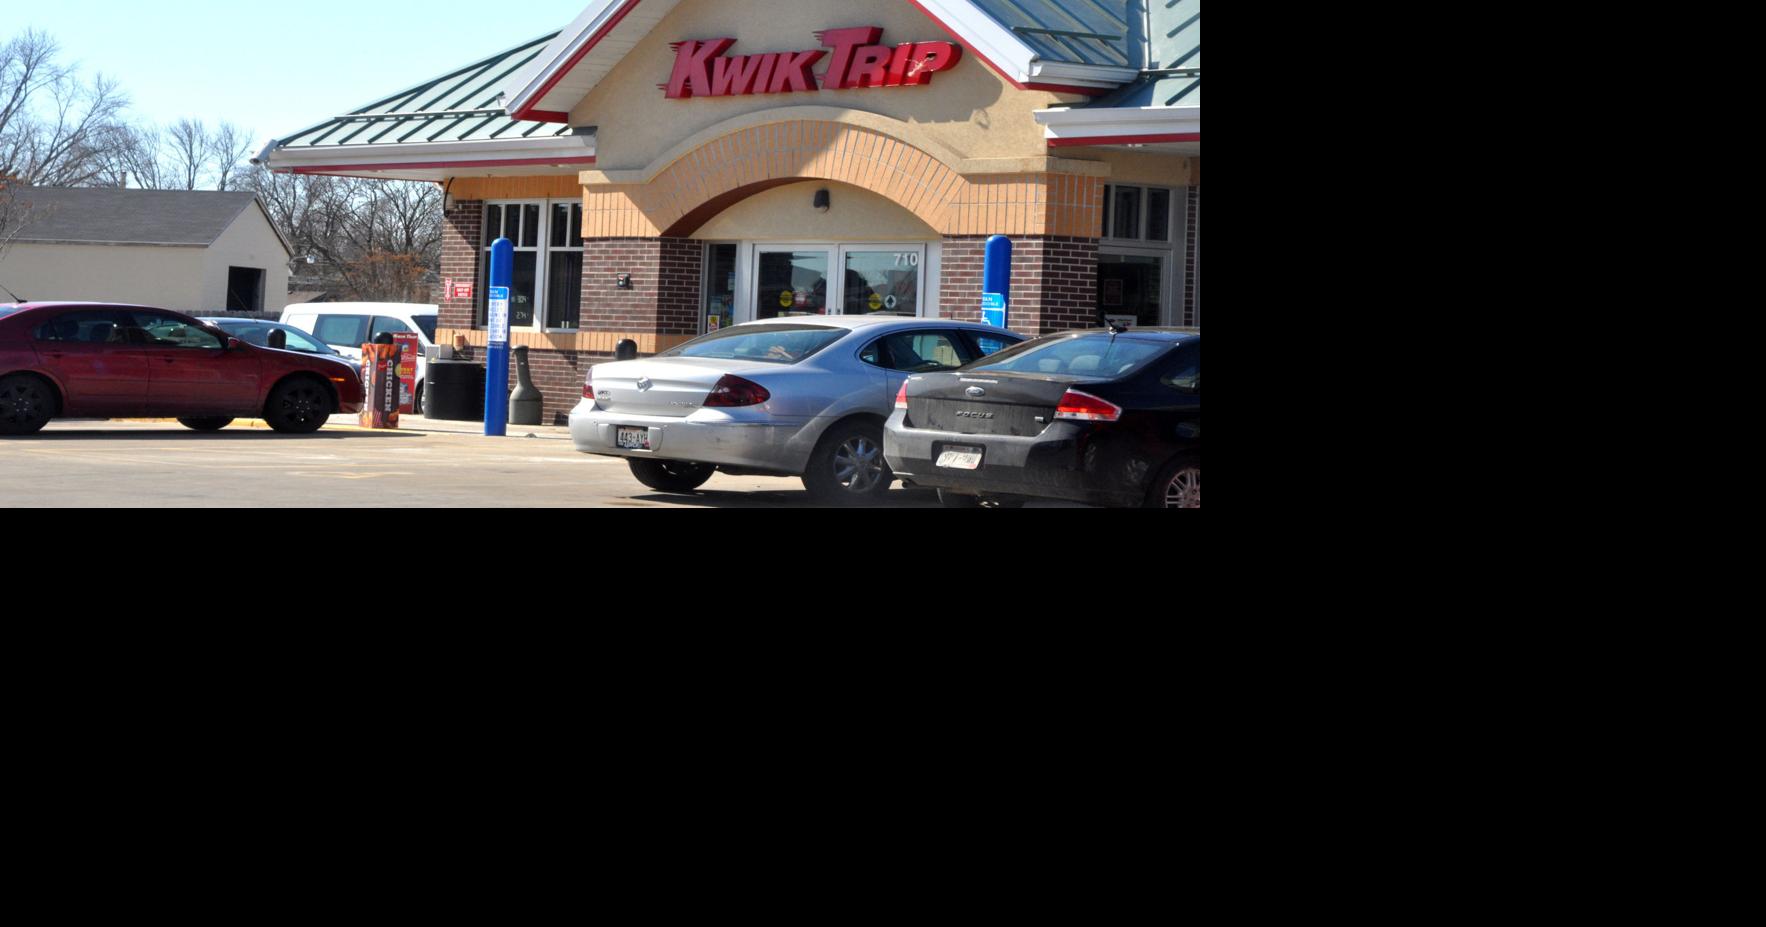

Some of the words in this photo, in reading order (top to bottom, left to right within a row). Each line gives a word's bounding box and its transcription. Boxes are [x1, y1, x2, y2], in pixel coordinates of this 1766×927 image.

[657, 37, 827, 99] KWIK
[813, 26, 963, 90] TRIP
[893, 252, 918, 266] 710
[385, 359, 394, 412] CHICKEN
[956, 410, 994, 419] FOCUS
